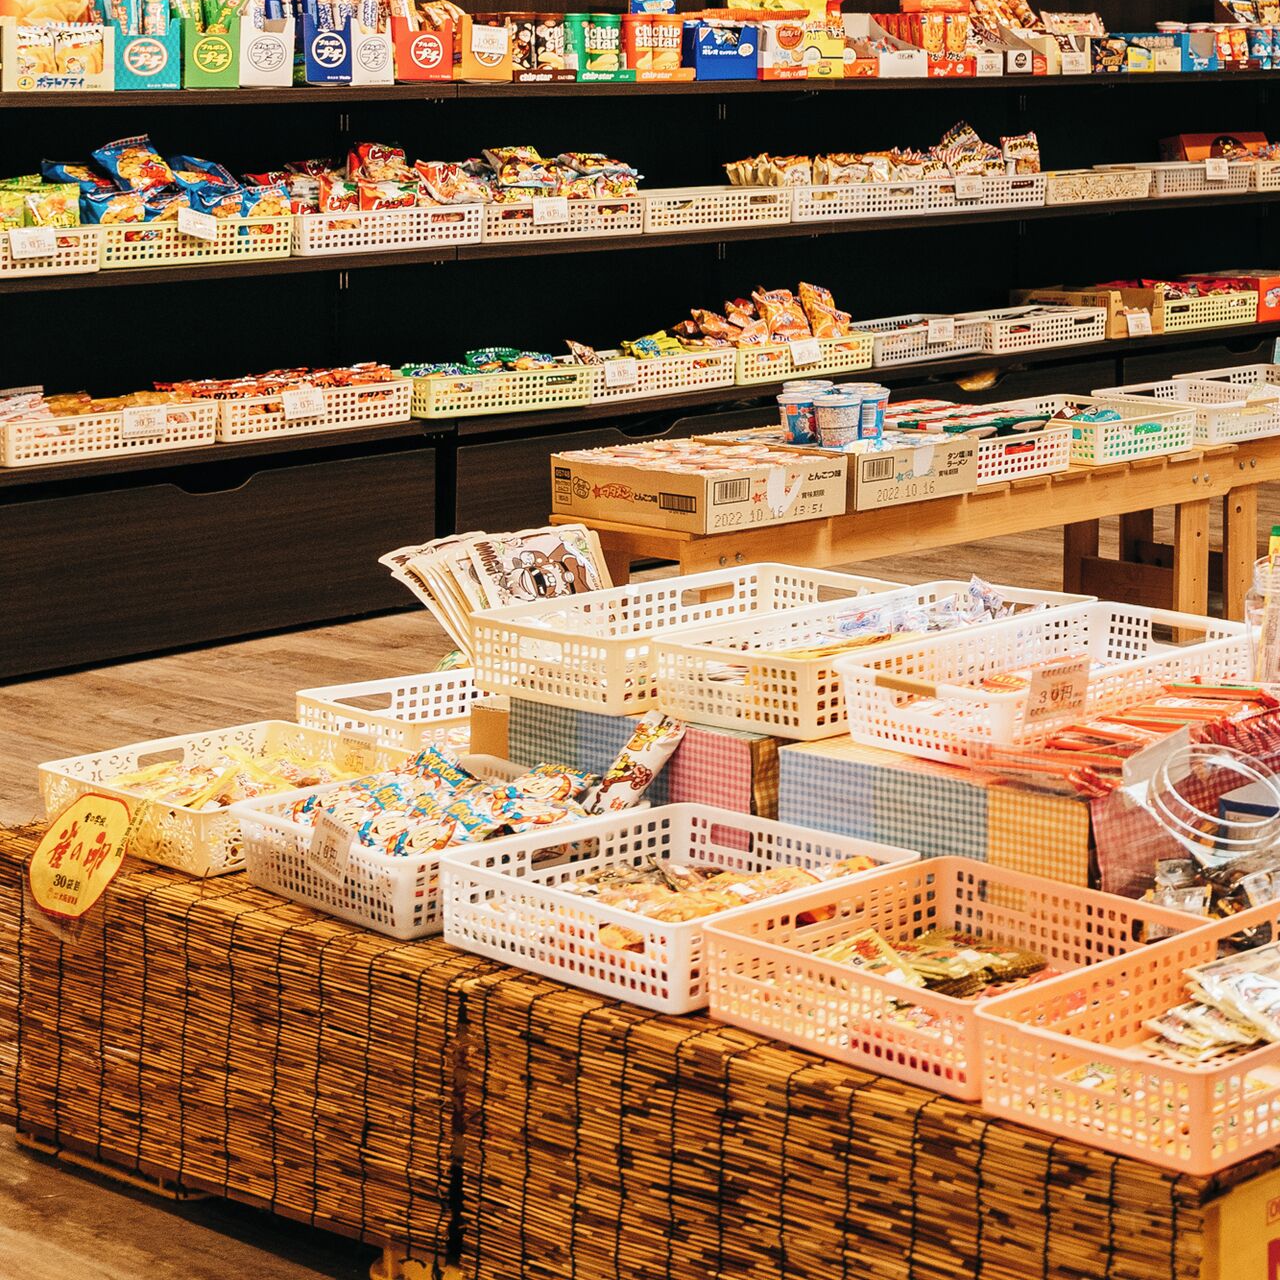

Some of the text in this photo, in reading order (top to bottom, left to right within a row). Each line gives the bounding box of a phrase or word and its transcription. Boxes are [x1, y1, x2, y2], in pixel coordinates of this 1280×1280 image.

[590, 27, 620, 40] chip
[652, 26, 681, 39] chip
[316, 39, 342, 48] ブルボン
[589, 38, 620, 50] star
[651, 37, 681, 49] star
[314, 47, 344, 64] プチ
[807, 469, 842, 481] とんこつ味
